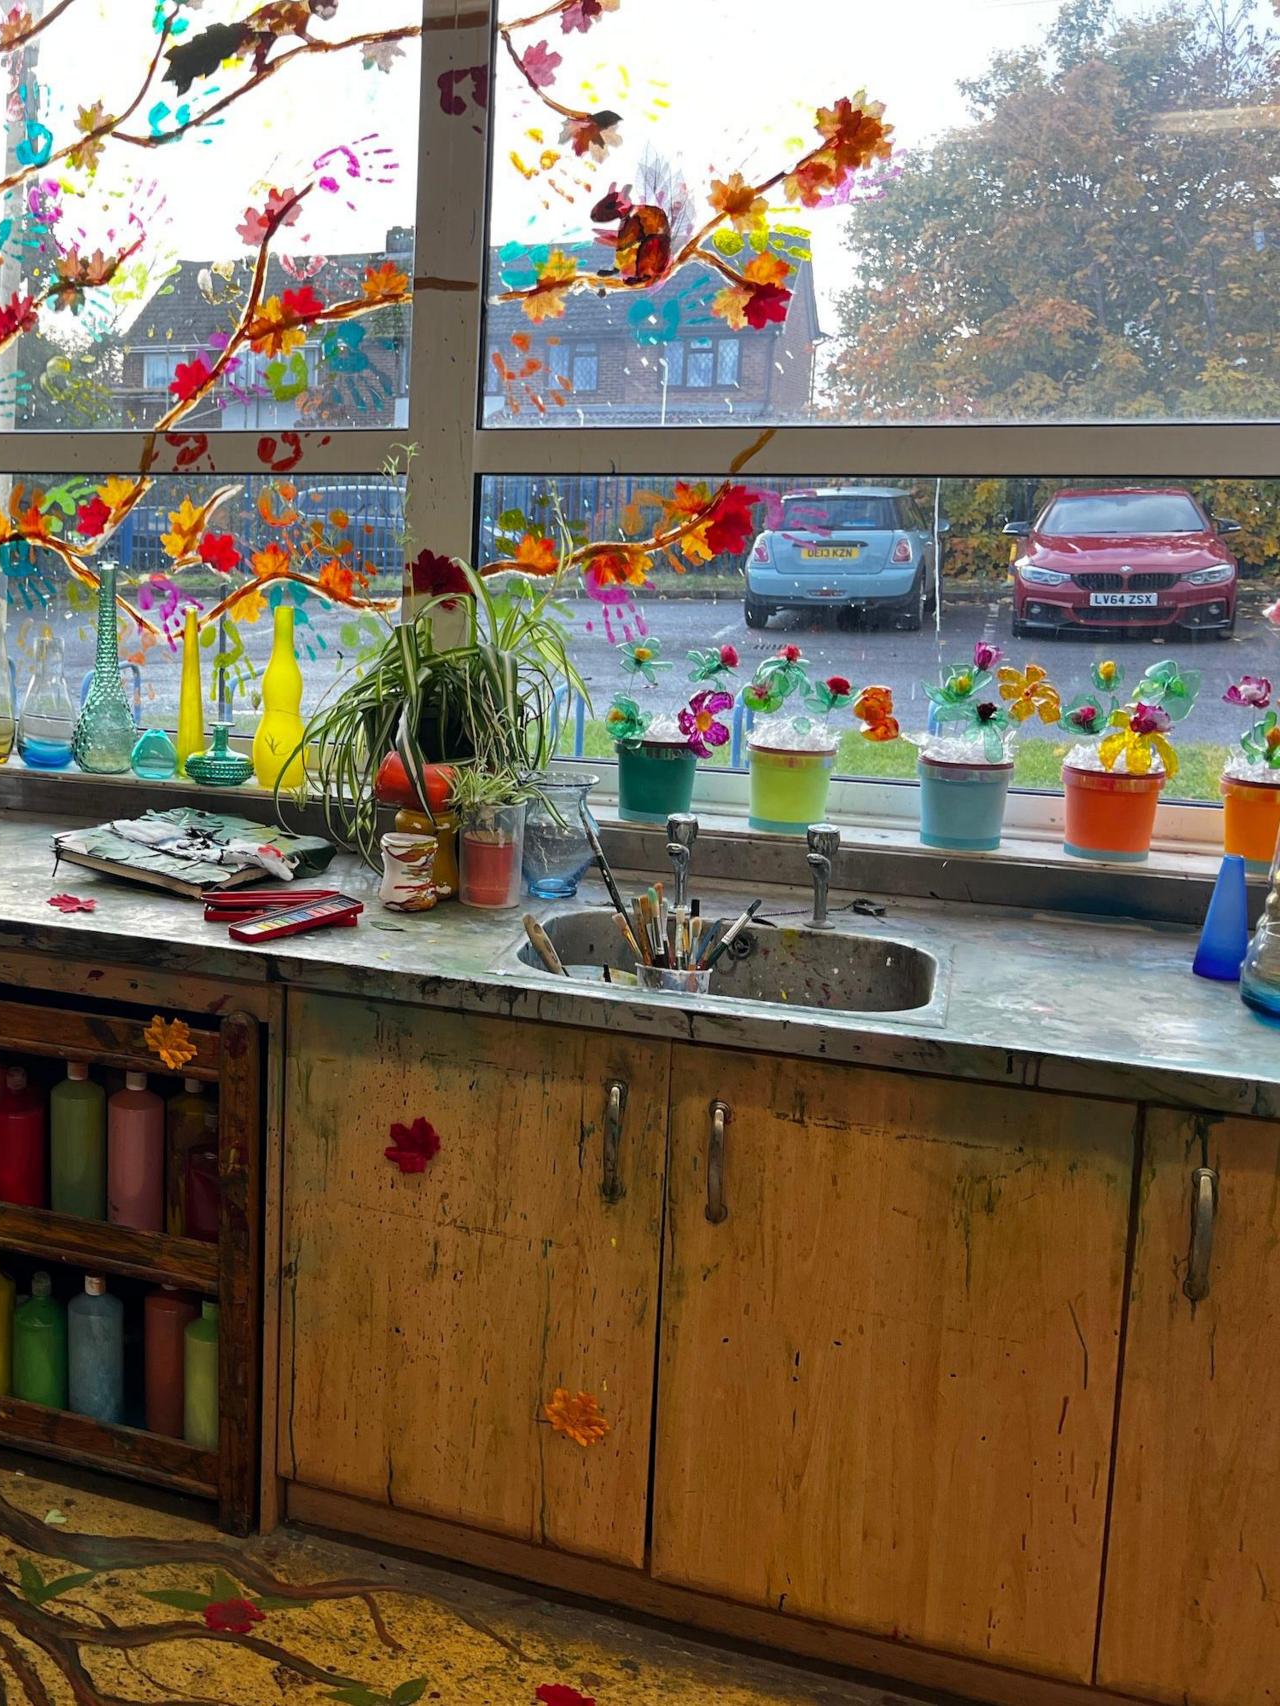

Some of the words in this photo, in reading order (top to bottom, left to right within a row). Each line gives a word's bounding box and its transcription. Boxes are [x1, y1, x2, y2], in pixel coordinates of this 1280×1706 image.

[832, 548, 852, 558] KZN
[1094, 594, 1125, 604] LV64
[1129, 594, 1152, 604] ZSX
